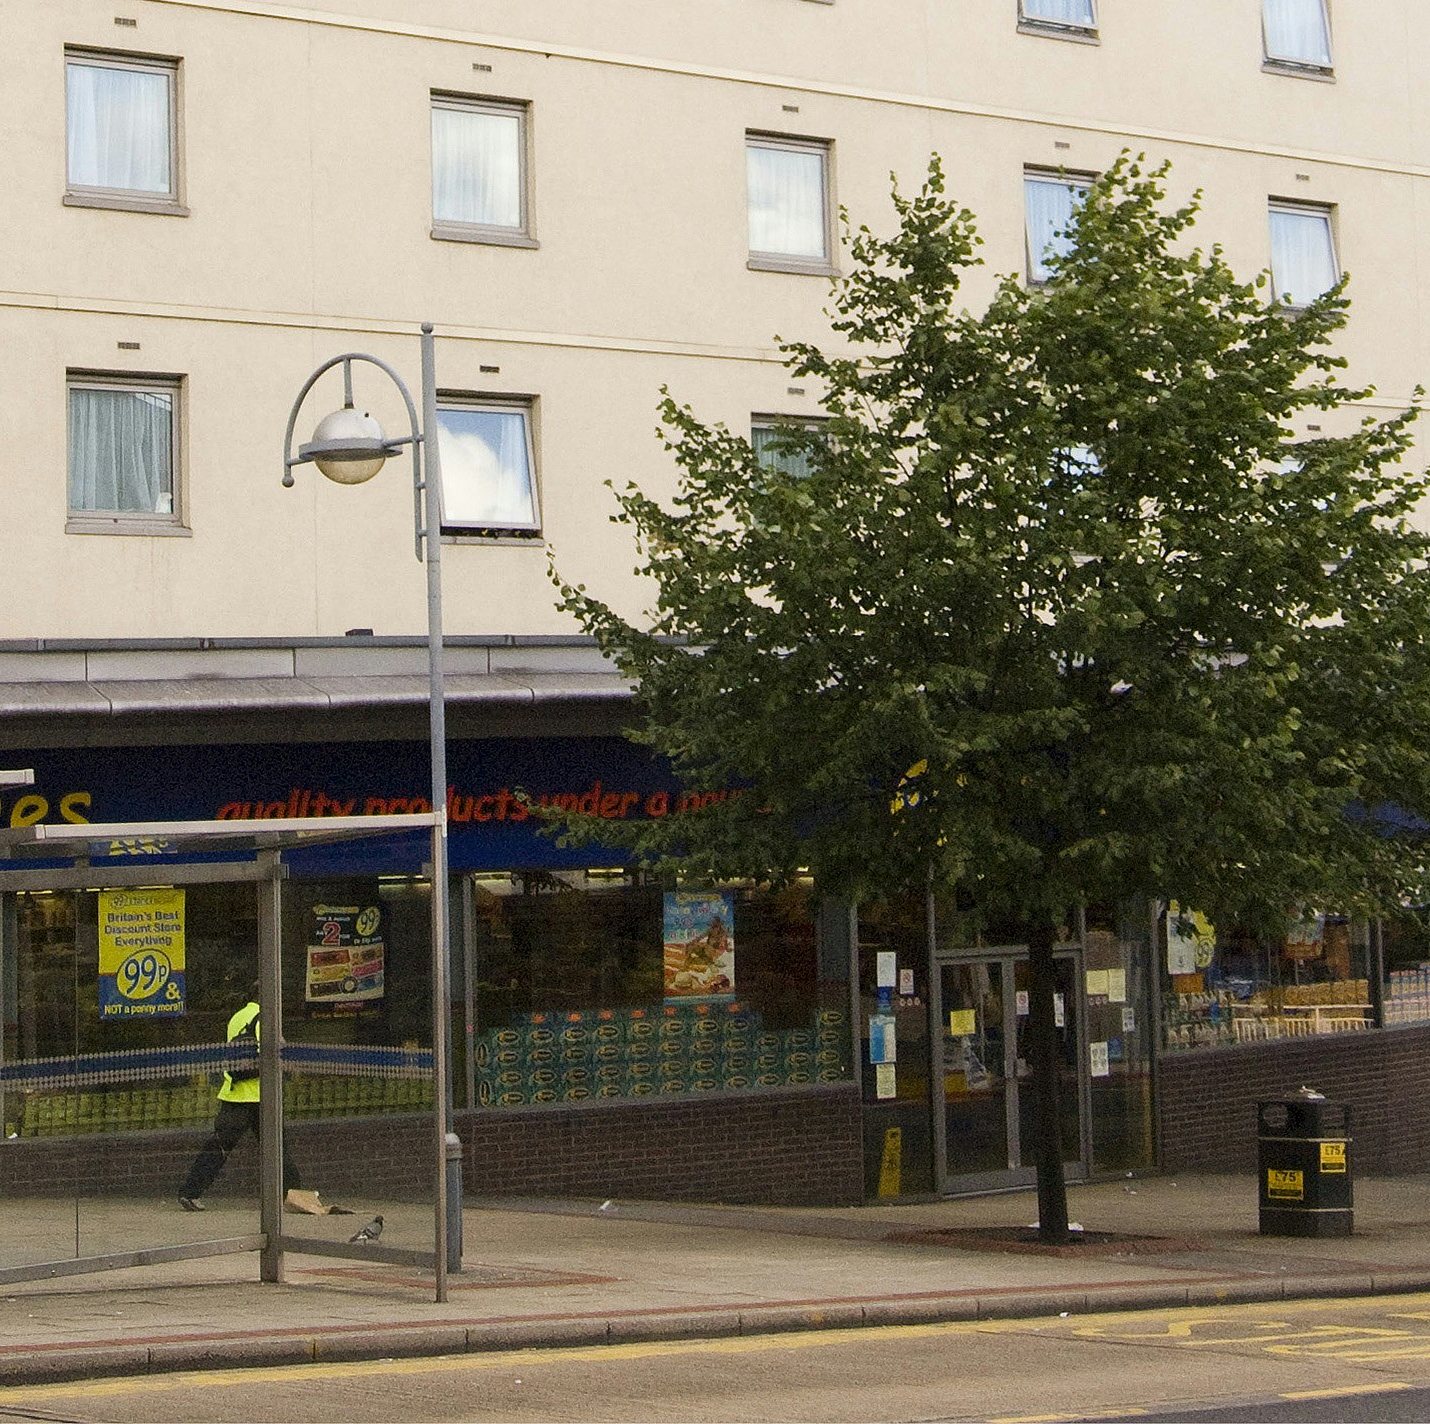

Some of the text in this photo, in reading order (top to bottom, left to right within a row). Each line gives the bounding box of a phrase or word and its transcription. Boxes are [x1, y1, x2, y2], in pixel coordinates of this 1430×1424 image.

[107, 910, 179, 922] Britain's Best
[105, 922, 180, 934] Discount Store
[322, 921, 341, 946] 2
[115, 935, 172, 947] Everything
[124, 955, 167, 995] 99p
[165, 981, 181, 1000] &
[105, 1004, 123, 1015] NOT
[131, 1003, 156, 1015] penny
